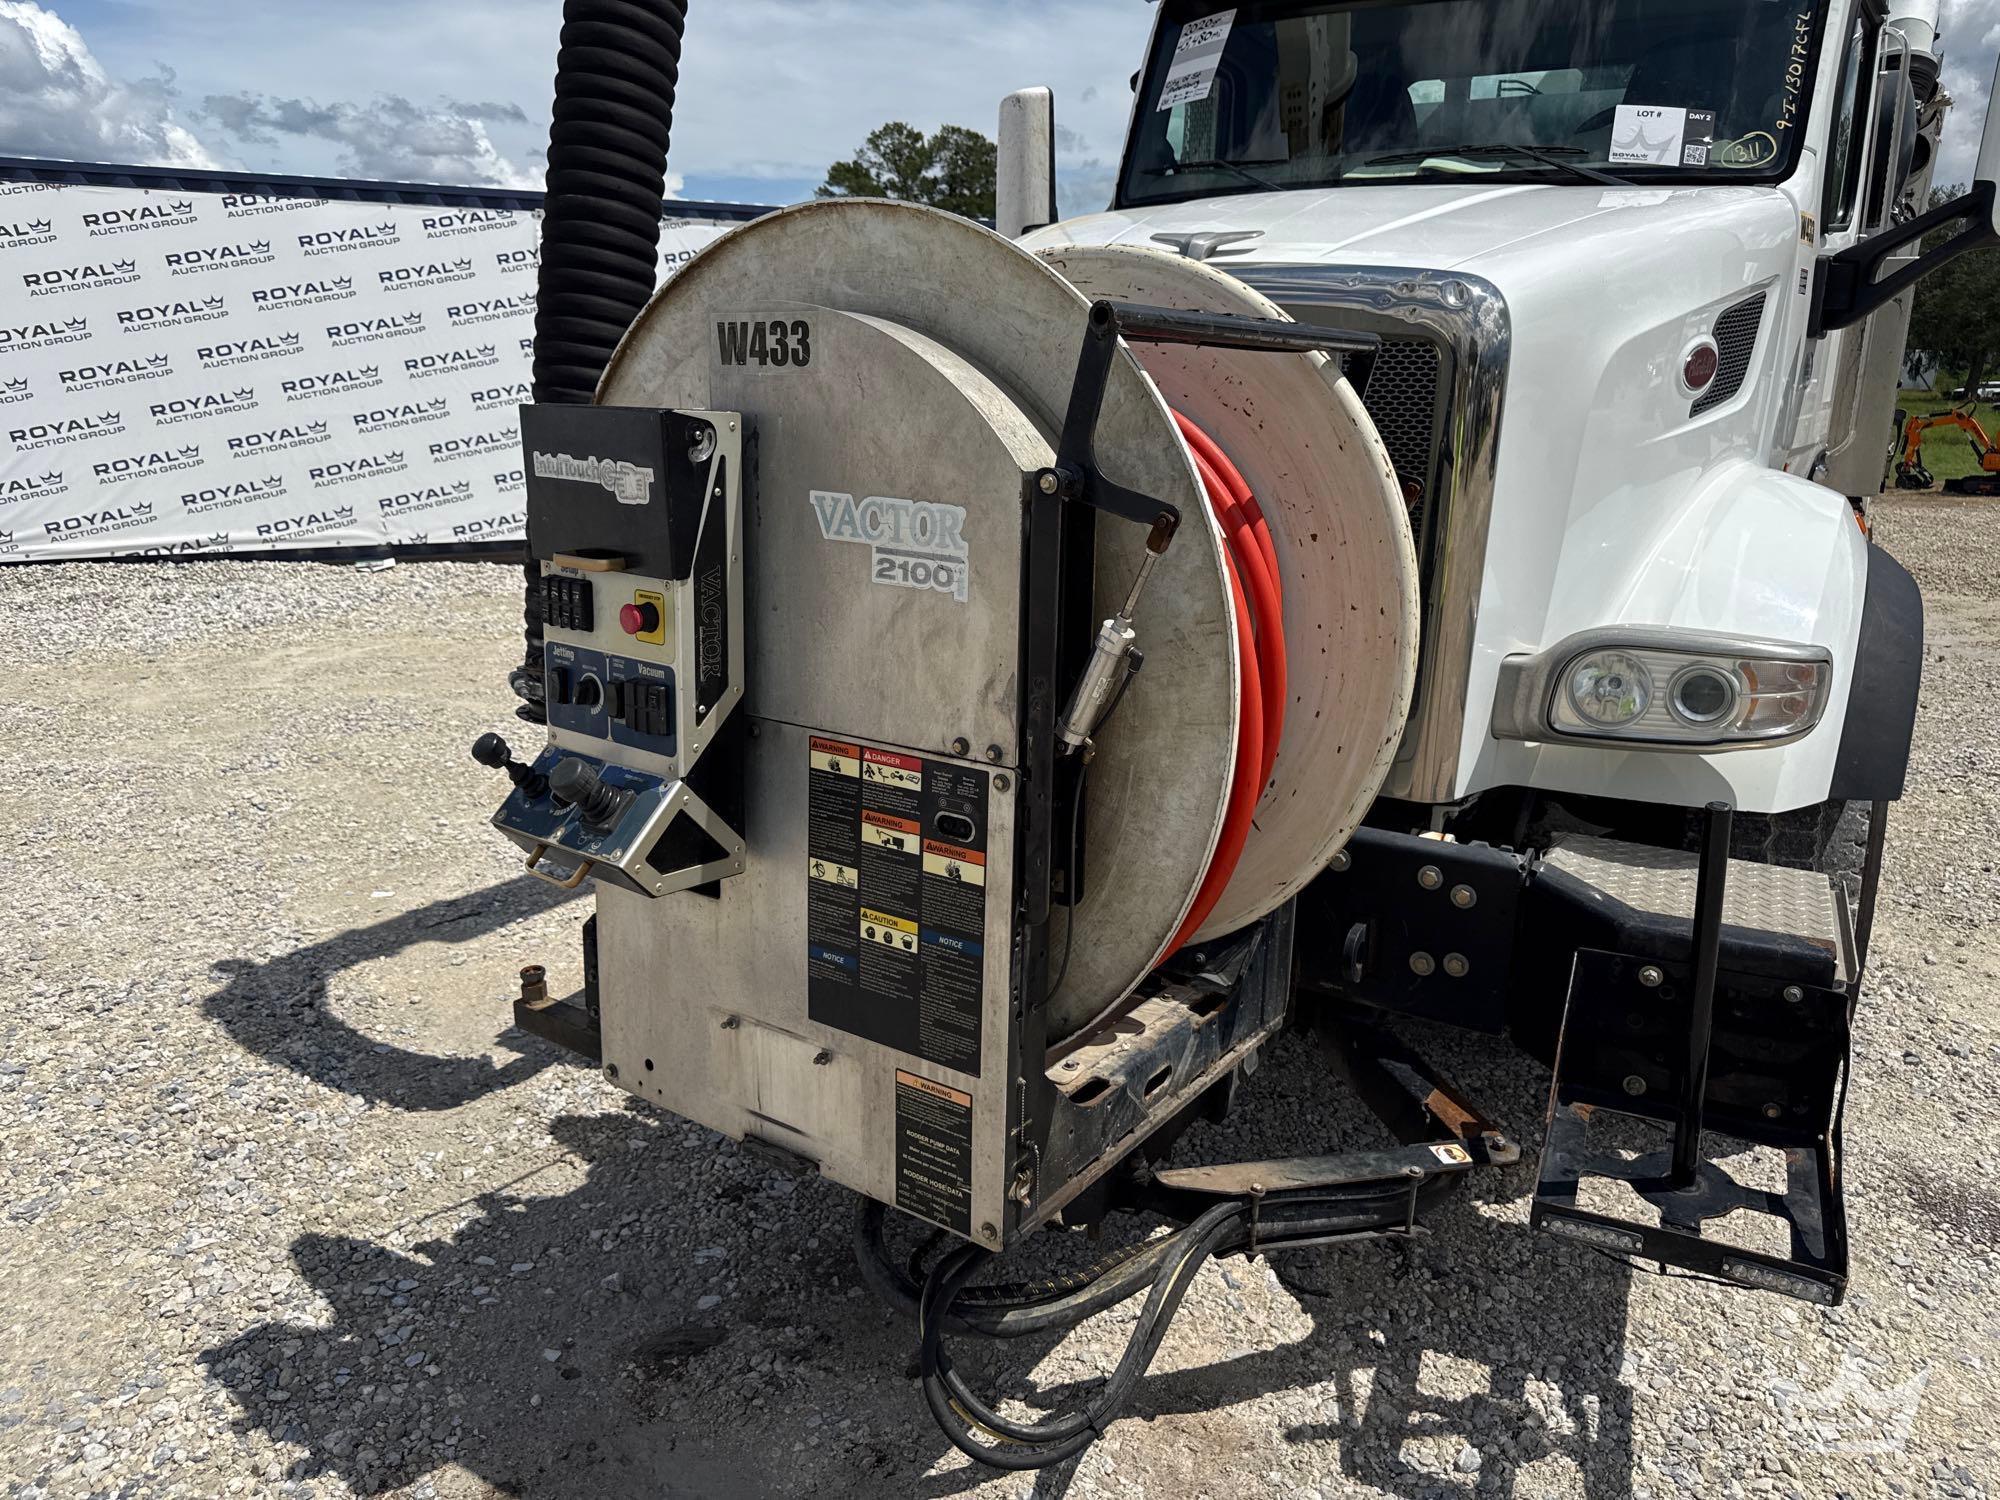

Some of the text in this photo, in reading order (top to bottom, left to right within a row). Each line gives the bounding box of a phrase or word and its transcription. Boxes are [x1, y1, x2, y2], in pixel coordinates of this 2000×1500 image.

[1637, 110, 1655, 118] LOT
[83, 205, 172, 227] ROYAL
[227, 199, 329, 218] AUCTION GROUP
[90, 216, 198, 237] AUCTION GROUP
[422, 210, 496, 230] ROYAL
[427, 220, 517, 239] AUCTION GROUP
[8, 235, 57, 248] GROUP
[298, 227, 377, 248] ROYAL
[303, 237, 401, 257] AUCTION GROUP
[165, 245, 250, 266] ROYAL
[171, 255, 275, 276] AUCTION GROUP
[496, 248, 538, 265] ROY
[23, 264, 115, 287] ROYAL
[378, 263, 454, 283] ROYAL
[500, 262, 540, 274] AUCTIO
[30, 274, 141, 297] AUCTION GROUP
[252, 281, 333, 302] ROYAL
[383, 272, 476, 292] AUCTION GROUP
[117, 301, 204, 324] ROYAL
[257, 291, 357, 312] AUCTION GROUP
[447, 298, 519, 318] ROYAL
[123, 311, 229, 334] AUCTION GROUP
[326, 317, 403, 338] ROYAL
[451, 313, 500, 327] AUCTION
[0, 323, 65, 343] OYAL
[0, 332, 92, 353] CTION GROUP
[331, 326, 426, 347] AUCTION GROUP
[717, 320, 811, 366] W433
[197, 338, 280, 360] ROYAL
[203, 347, 304, 369] AUCTION GROUP
[404, 349, 478, 371] ROYAL
[59, 359, 148, 383] ROYAL
[409, 358, 499, 380] AUCTION GROUP
[65, 369, 174, 393] AUCTION GROUP
[281, 370, 360, 393] ROYAL
[286, 379, 383, 403] AUCTION GROUP
[471, 383, 530, 403] ROYA
[475, 397, 523, 411] AUCTION
[149, 393, 234, 417] ROYAL
[156, 401, 259, 426] AUCTION GROUP
[353, 403, 429, 426] ROYAL
[9, 418, 100, 443] ROYAL
[358, 411, 451, 435] AUCTION GROUP
[16, 426, 126, 452] AUCTION GROUP
[227, 427, 309, 450] ROYAL
[232, 434, 332, 459] AUCTION GROUP
[429, 433, 501, 455] ROYAL
[433, 440, 521, 464] AUCTION GROUP
[93, 451, 180, 476] ROYAL
[99, 459, 205, 485] AUCTION GROUP
[309, 456, 386, 480] ROYAL
[314, 463, 408, 488] AUCTION GROUP
[20, 486, 69, 500] GROUP
[181, 481, 263, 506] ROYAL
[187, 489, 288, 515] AUCTION GROUP
[379, 486, 452, 509] ROYAL
[435, 493, 474, 507] GROUP
[44, 508, 132, 534] ROYAL
[50, 515, 158, 543] AUCTION GROUP
[256, 512, 335, 536] ROYAL
[261, 518, 357, 544] AUCTION GROUP
[453, 513, 523, 536] ROYAL
[813, 495, 966, 549] VACTOR
[701, 566, 721, 681] VACTOR
[553, 646, 575, 661] Jetting
[638, 663, 665, 679] Vacuum
[818, 743, 849, 755] WARNING
[872, 753, 901, 765] DANGER
[871, 815, 903, 829] WARNING
[932, 844, 966, 859] WARNING
[869, 913, 898, 927] CAUTION
[939, 936, 963, 949] NOTICE
[823, 952, 844, 964] NOTICE
[920, 1083, 952, 1099] WARNING
[945, 1144, 960, 1155] DATA
[903, 1168, 963, 1198] RODDER HOSE DATA
